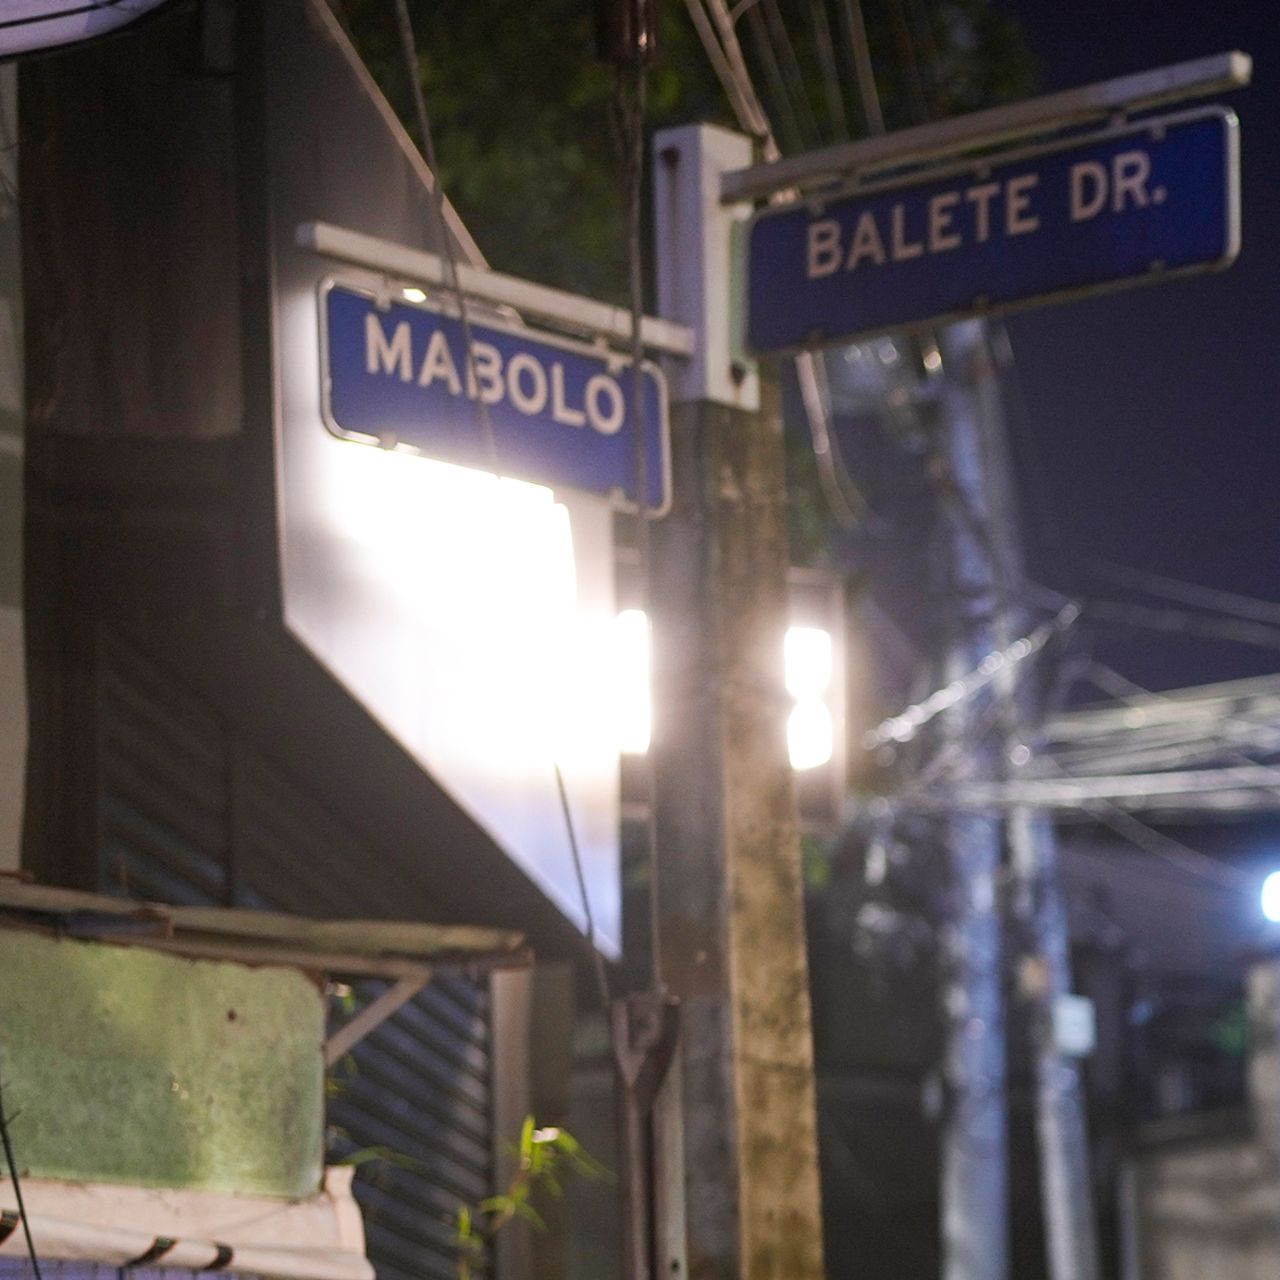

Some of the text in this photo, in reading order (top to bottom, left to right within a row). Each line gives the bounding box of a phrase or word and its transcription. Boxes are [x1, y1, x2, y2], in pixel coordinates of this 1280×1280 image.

[806, 150, 1168, 279] BALETE DR.
[365, 312, 626, 435] MABOLO
